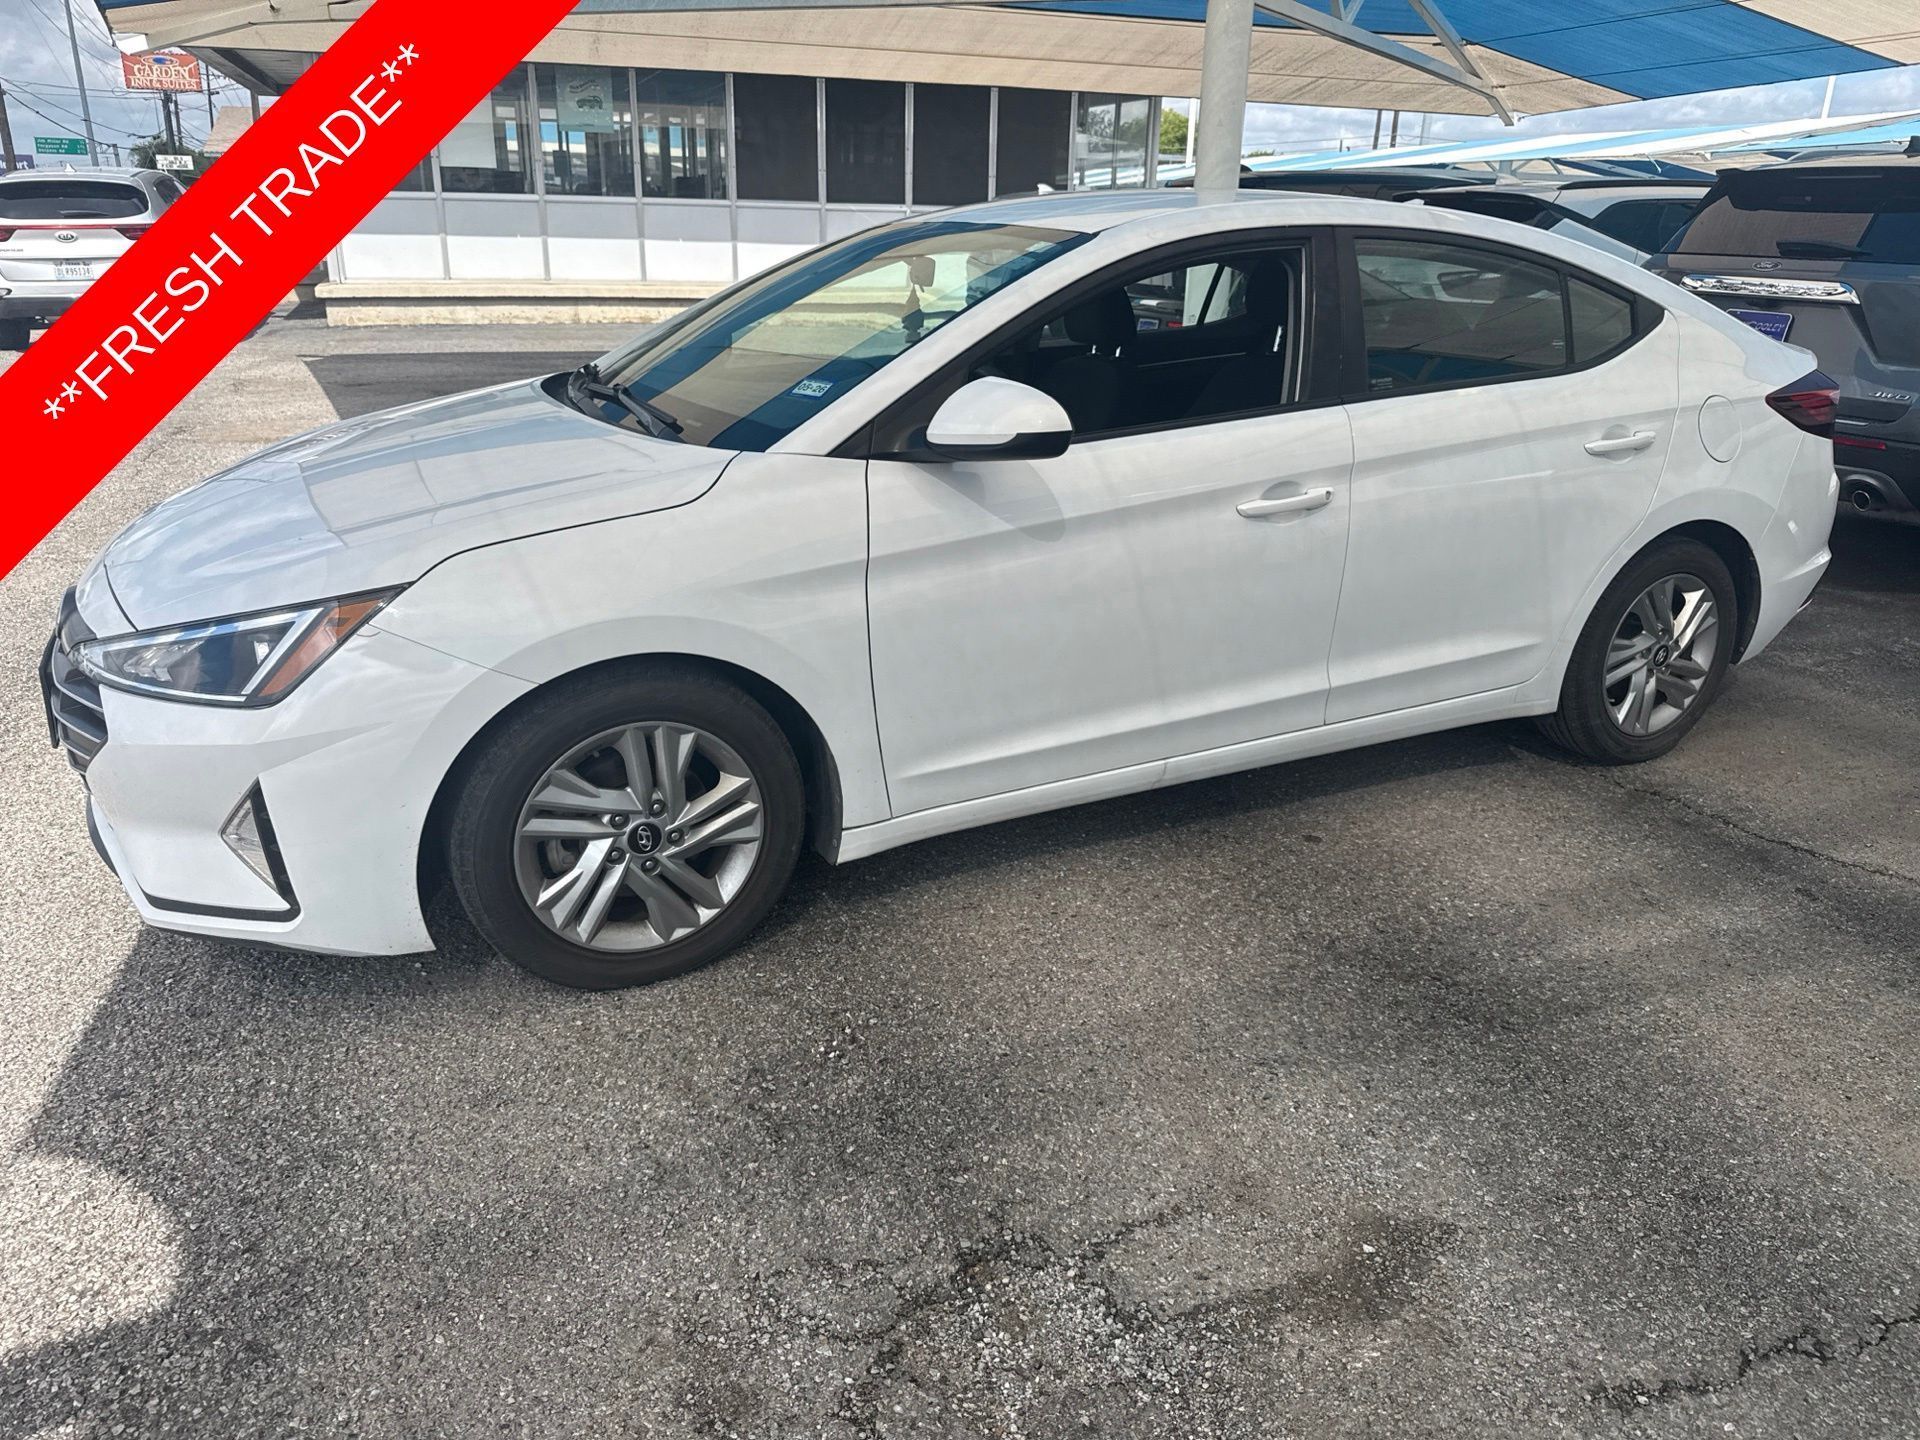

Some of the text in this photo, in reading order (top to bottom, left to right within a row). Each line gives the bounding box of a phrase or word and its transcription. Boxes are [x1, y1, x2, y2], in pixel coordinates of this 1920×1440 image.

[133, 64, 190, 81] GARDEN
[131, 77, 197, 89] INN & SUITES
